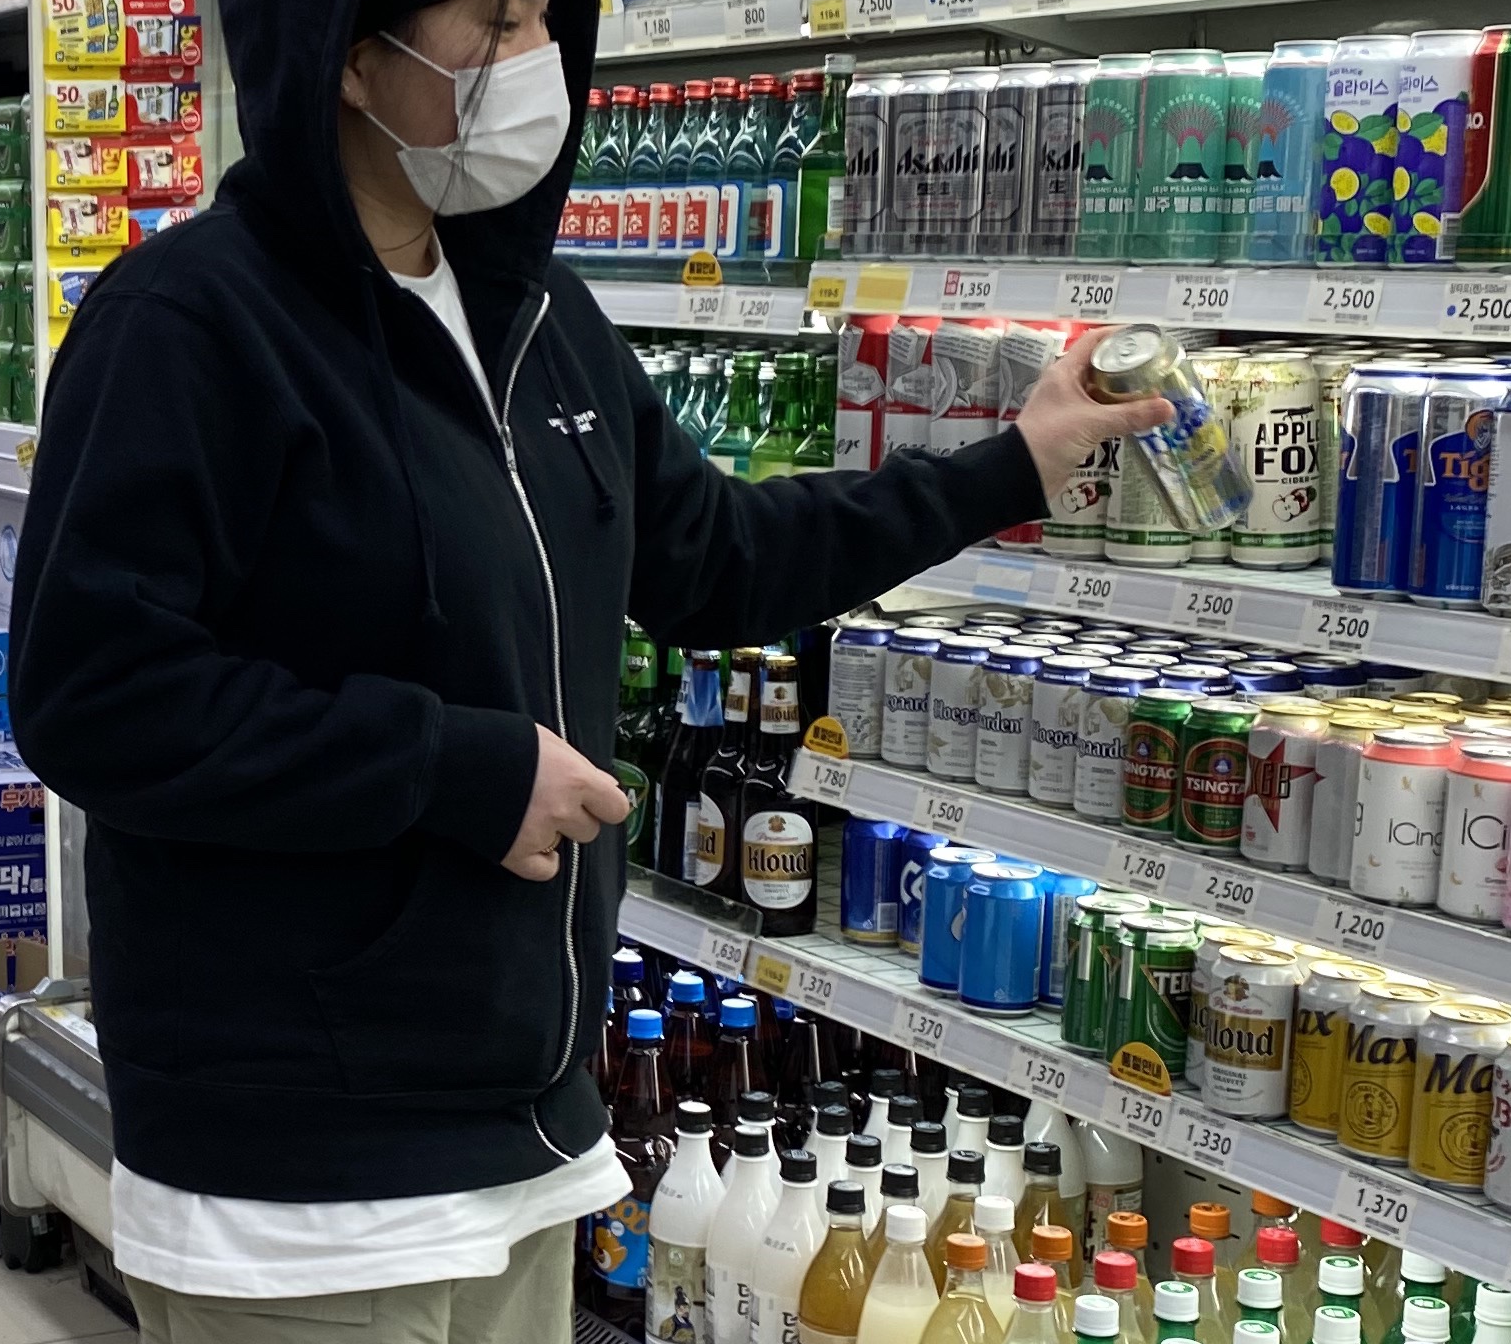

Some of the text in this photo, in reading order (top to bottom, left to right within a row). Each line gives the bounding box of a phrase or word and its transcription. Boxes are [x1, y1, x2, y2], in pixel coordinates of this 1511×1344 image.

[644, 19, 670, 36] 1,180
[745, 8, 765, 25] 800
[57, 86, 79, 104] 50
[959, 281, 991, 298] 1,350
[1070, 285, 1113, 307] 2,500
[1183, 287, 1229, 309] 2,500
[1323, 287, 1374, 309] 2,500
[689, 297, 718, 314] 1,300
[739, 300, 770, 317] 1,290
[1458, 298, 1511, 322] 2,500
[1281, 476, 1310, 484] CIDER
[1439, 449, 1488, 491] Tig
[1069, 577, 1111, 597] 2,500
[1187, 593, 1233, 615] 2,500
[1318, 614, 1369, 639] 2,500
[814, 765, 847, 787] 1,780
[1124, 758, 1177, 782] SINGTAO
[1186, 776, 1246, 794] TSINGTA
[926, 799, 963, 823] 1,500
[748, 846, 809, 874] Kloud
[1122, 854, 1165, 881] 1,780
[1206, 876, 1254, 905] 2,500
[1334, 911, 1384, 940] 1,200
[711, 939, 742, 963] 1,630
[797, 972, 832, 998] 1,370
[907, 1013, 943, 1039] 1,370
[1297, 1008, 1336, 1037] ax
[1026, 1060, 1065, 1089] 1,370
[1424, 1052, 1494, 1095] Ma
[1120, 1096, 1162, 1127] 1,370
[1187, 1124, 1232, 1156] 1,330
[1356, 1187, 1408, 1223] 1,370
